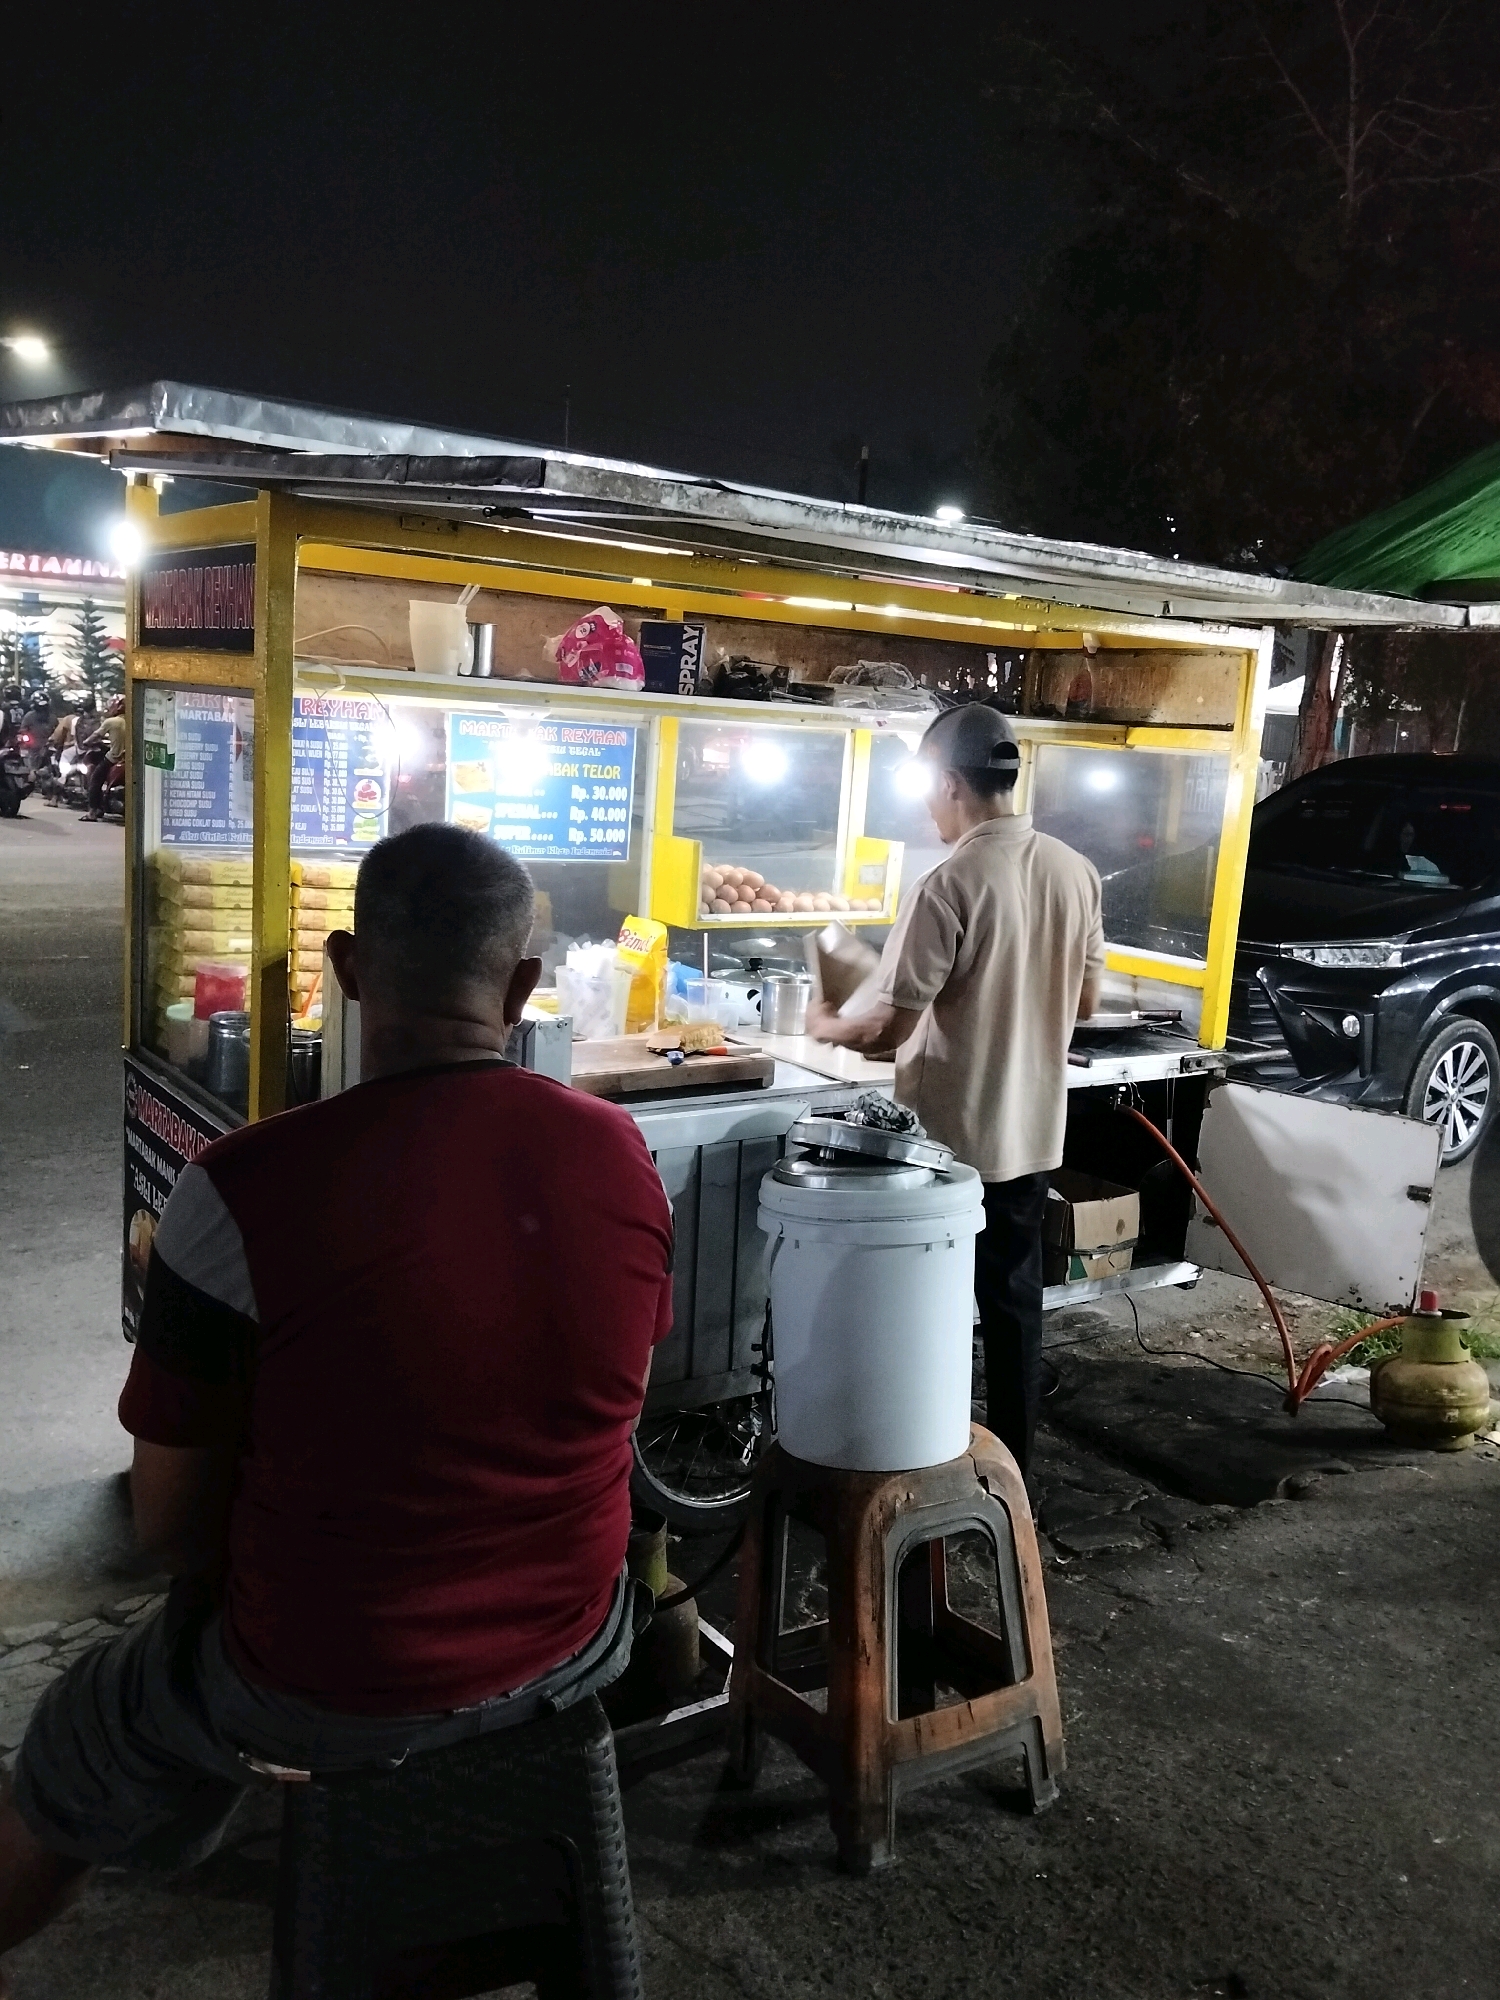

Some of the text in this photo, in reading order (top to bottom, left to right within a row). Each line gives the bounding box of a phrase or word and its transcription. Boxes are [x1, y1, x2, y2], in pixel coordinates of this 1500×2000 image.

[0, 552, 126, 579] ERTAMINA
[145, 563, 256, 629] MARTABAK REYHAN
[678, 625, 703, 696] SPRAY
[300, 698, 386, 720] REYHAN
[293, 718, 307, 728] SLI
[561, 727, 627, 746] REYHAN
[583, 764, 621, 780] TELOR
[571, 785, 628, 802] Rp. 30.000
[569, 806, 588, 824] Rp.
[591, 807, 627, 822] 40.000
[568, 827, 587, 845] Rp.
[590, 828, 626, 843] 50.000
[138, 1085, 197, 1163] MARTABAK
